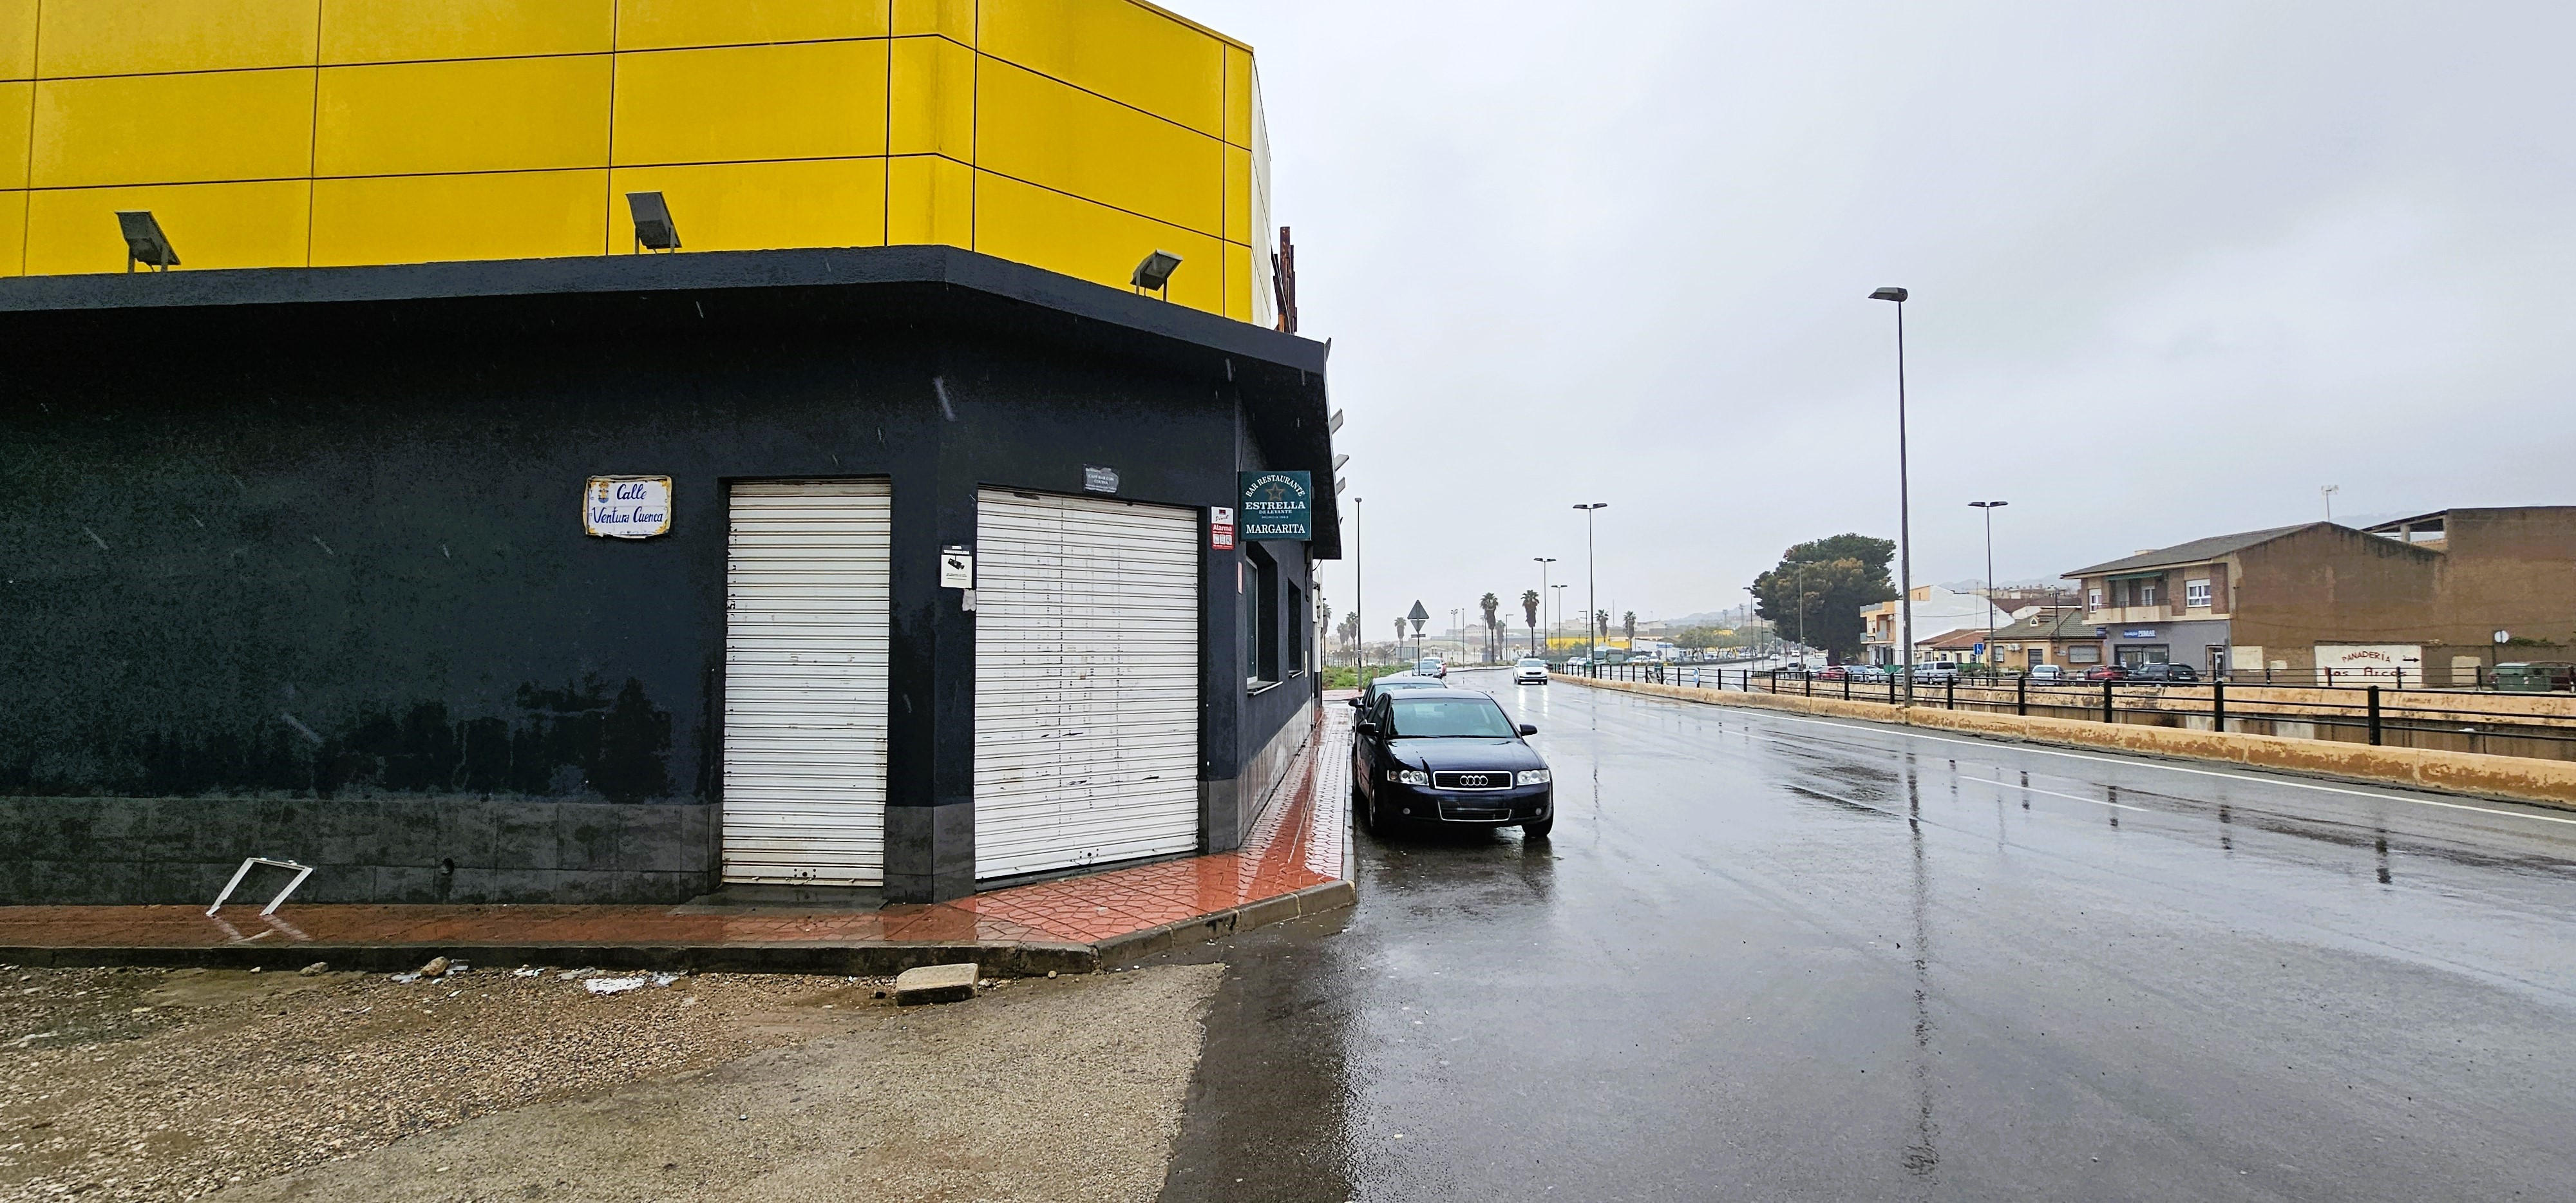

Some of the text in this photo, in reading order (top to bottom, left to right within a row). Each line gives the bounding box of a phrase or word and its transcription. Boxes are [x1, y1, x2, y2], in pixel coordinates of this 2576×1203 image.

[616, 484, 647, 500] Calle
[1245, 475, 1305, 497] BAR RESTAURANTE
[1245, 501, 1305, 510] ESTRELLA
[592, 506, 663, 524] Ventura Cuenca
[1246, 524, 1305, 534] MARGARITA
[2342, 651, 2391, 663] PANADERÍA
